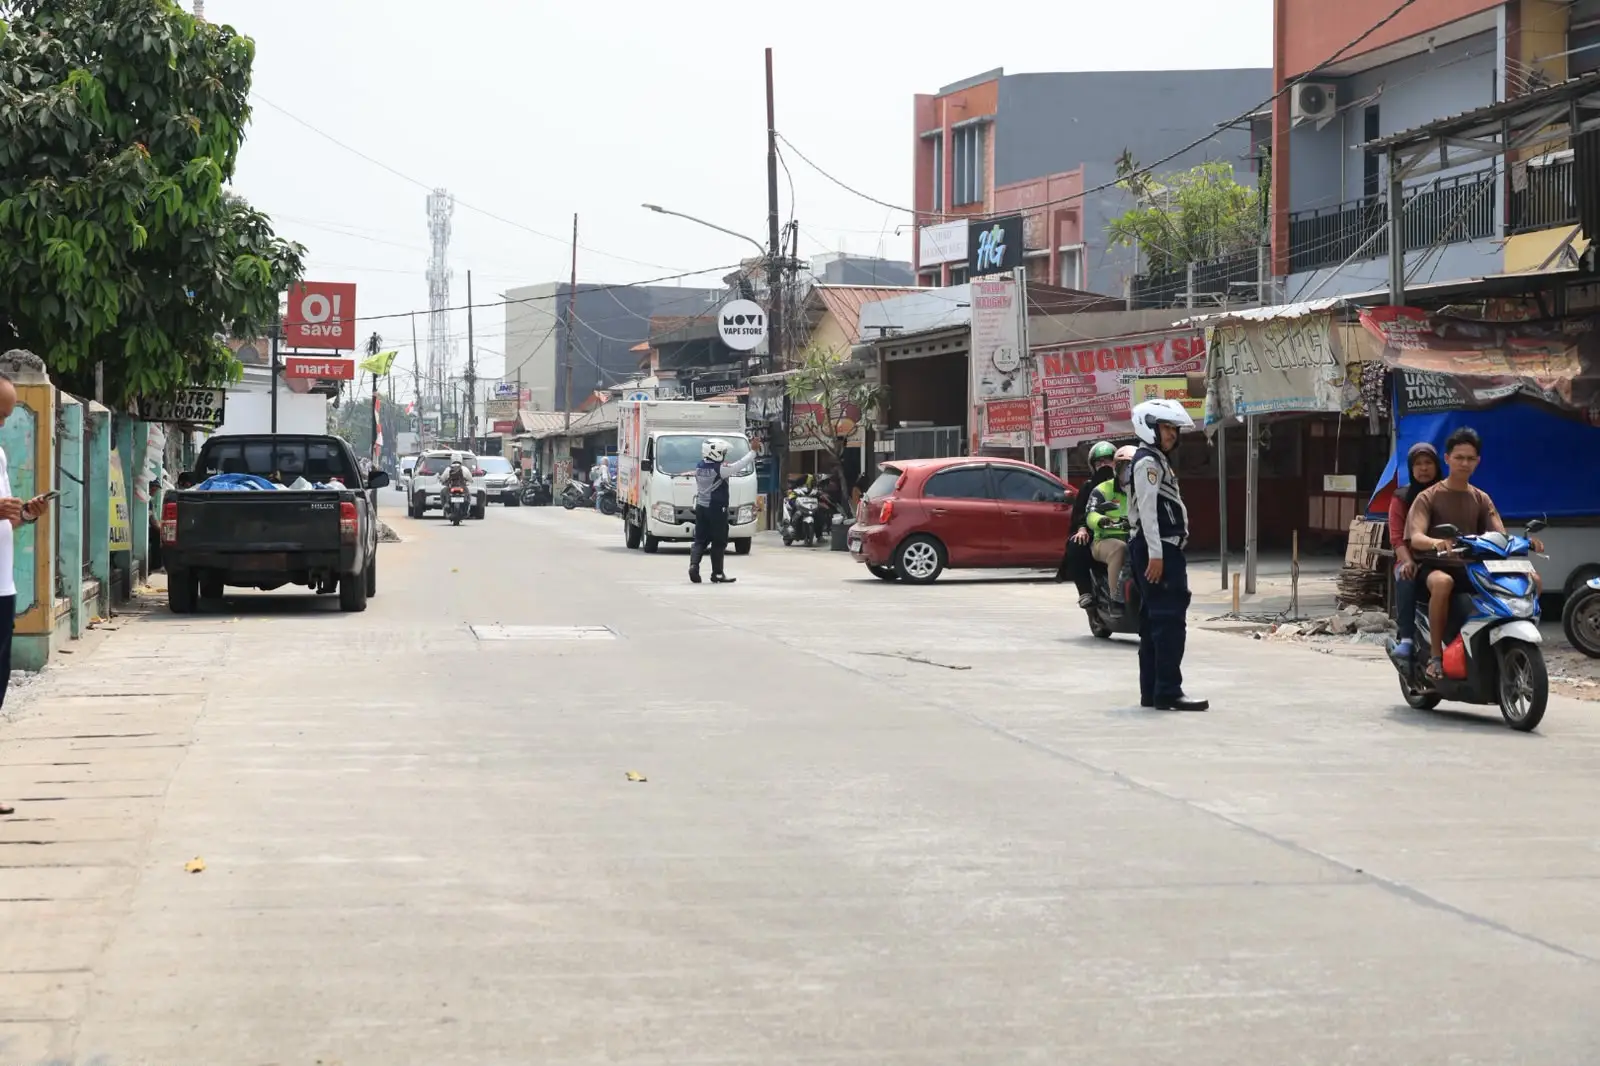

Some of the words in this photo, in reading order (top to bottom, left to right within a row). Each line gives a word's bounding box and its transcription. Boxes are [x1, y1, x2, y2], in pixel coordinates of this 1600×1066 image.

[301, 293, 341, 324] O!
[723, 314, 763, 326] MOVI
[300, 324, 342, 337] save
[723, 327, 741, 335] VAPE
[742, 327, 763, 335] STORE
[1043, 341, 1166, 376] NAUGHTY
[295, 363, 331, 375] mart
[1404, 371, 1446, 387] UANG
[1406, 400, 1432, 408] DALAM
